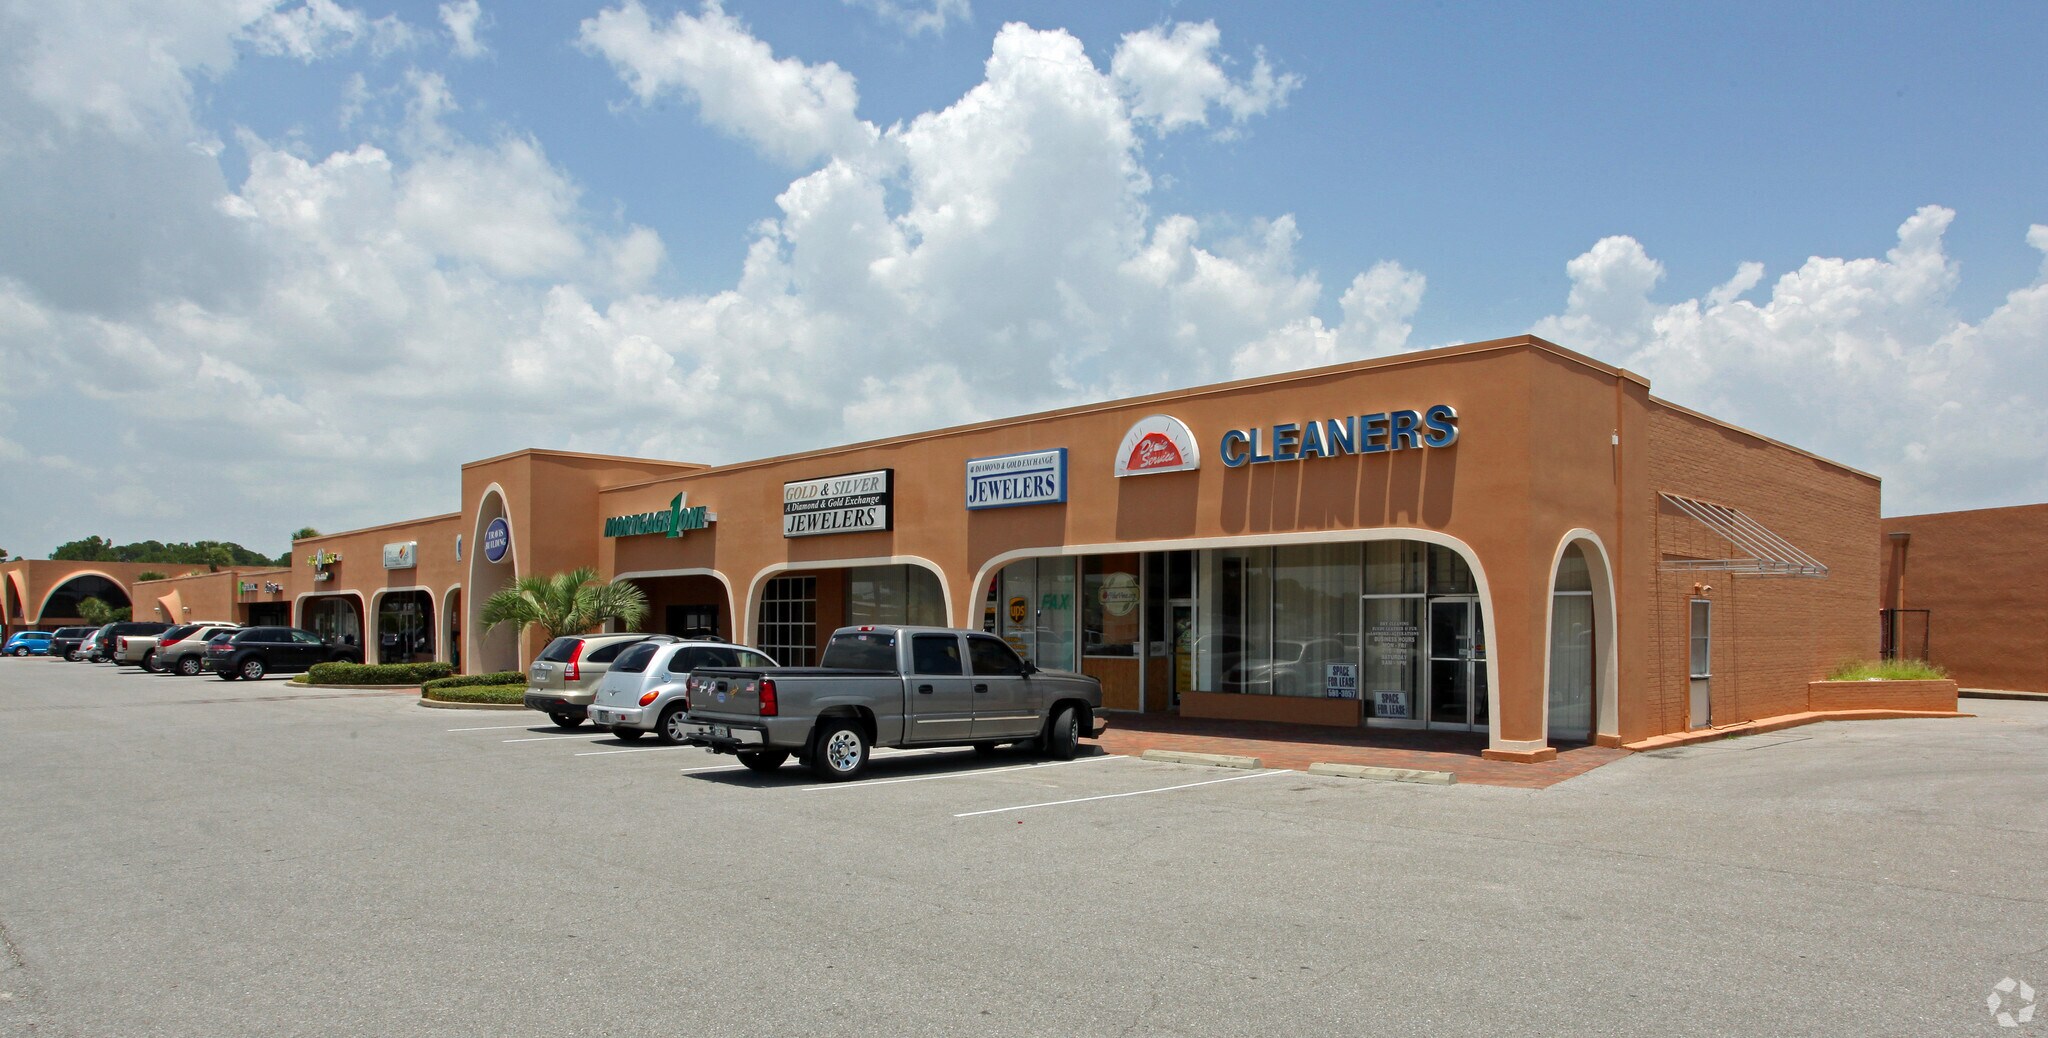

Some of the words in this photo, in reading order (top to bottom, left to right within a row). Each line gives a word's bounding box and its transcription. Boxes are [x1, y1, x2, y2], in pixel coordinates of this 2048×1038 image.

[1220, 404, 1459, 467] CLEANERS
[975, 463, 1001, 473] DIAMOND
[1006, 460, 1022, 469] GOLD
[1022, 455, 1054, 467] EXCHANGE
[786, 485, 818, 501] GOLD
[820, 482, 829, 496] &
[832, 476, 879, 496] SILVER
[969, 474, 1055, 503] JEWELERS
[785, 504, 791, 512] A
[791, 501, 819, 511] Diamond
[820, 499, 826, 508] &
[827, 497, 843, 507] Gold
[844, 495, 880, 506] Exchange
[604, 510, 672, 537] MORTGAGE
[665, 491, 684, 538] 1
[678, 506, 707, 530] ONE
[787, 507, 877, 532] JEWELERS
[1041, 593, 1070, 610] FAX
[1332, 665, 1349, 677] SPACE
[1328, 676, 1338, 688] FOR
[1340, 676, 1355, 688] LEASE
[1381, 693, 1399, 704] SPACE
[1377, 704, 1388, 715] FOR
[1389, 704, 1406, 716] LEASE
